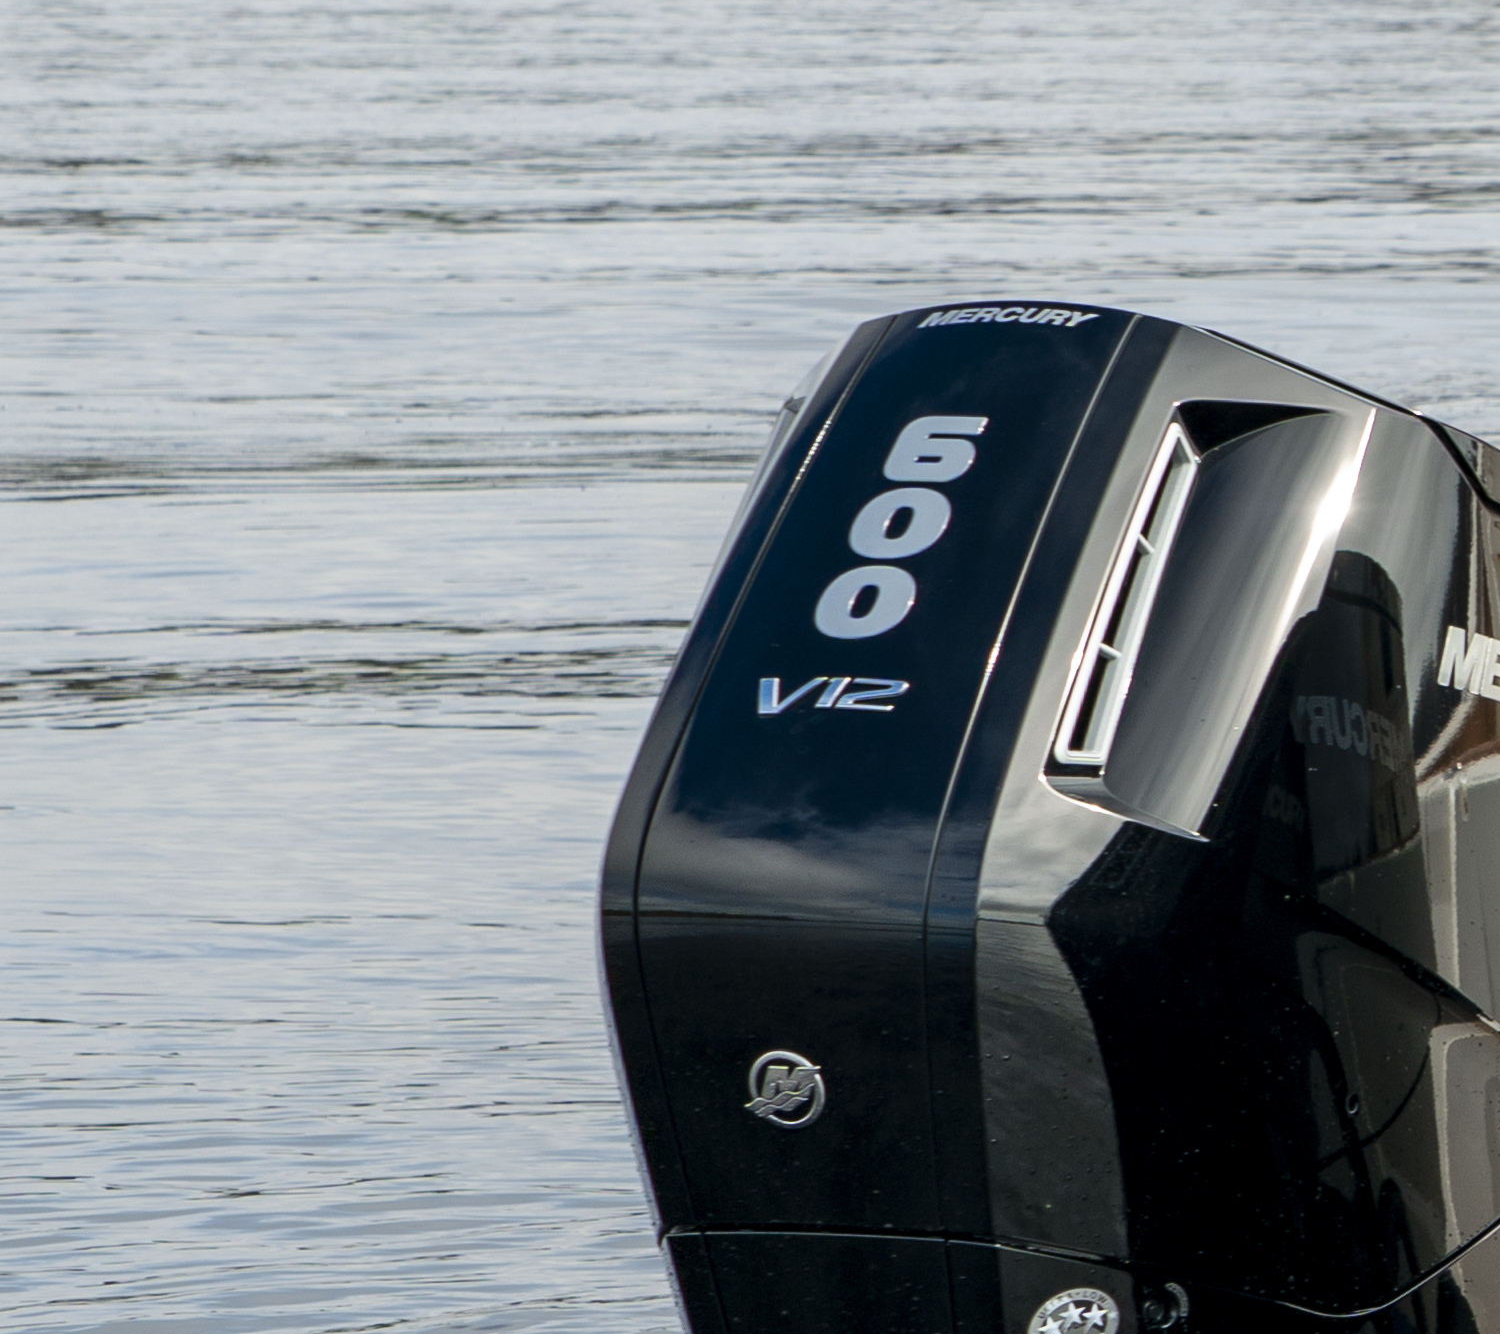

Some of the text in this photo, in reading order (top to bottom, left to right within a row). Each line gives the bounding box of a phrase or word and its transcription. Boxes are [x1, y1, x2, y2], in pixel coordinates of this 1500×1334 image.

[917, 306, 1100, 329] MERCURY
[814, 415, 989, 640] 600
[757, 676, 910, 716] V12
